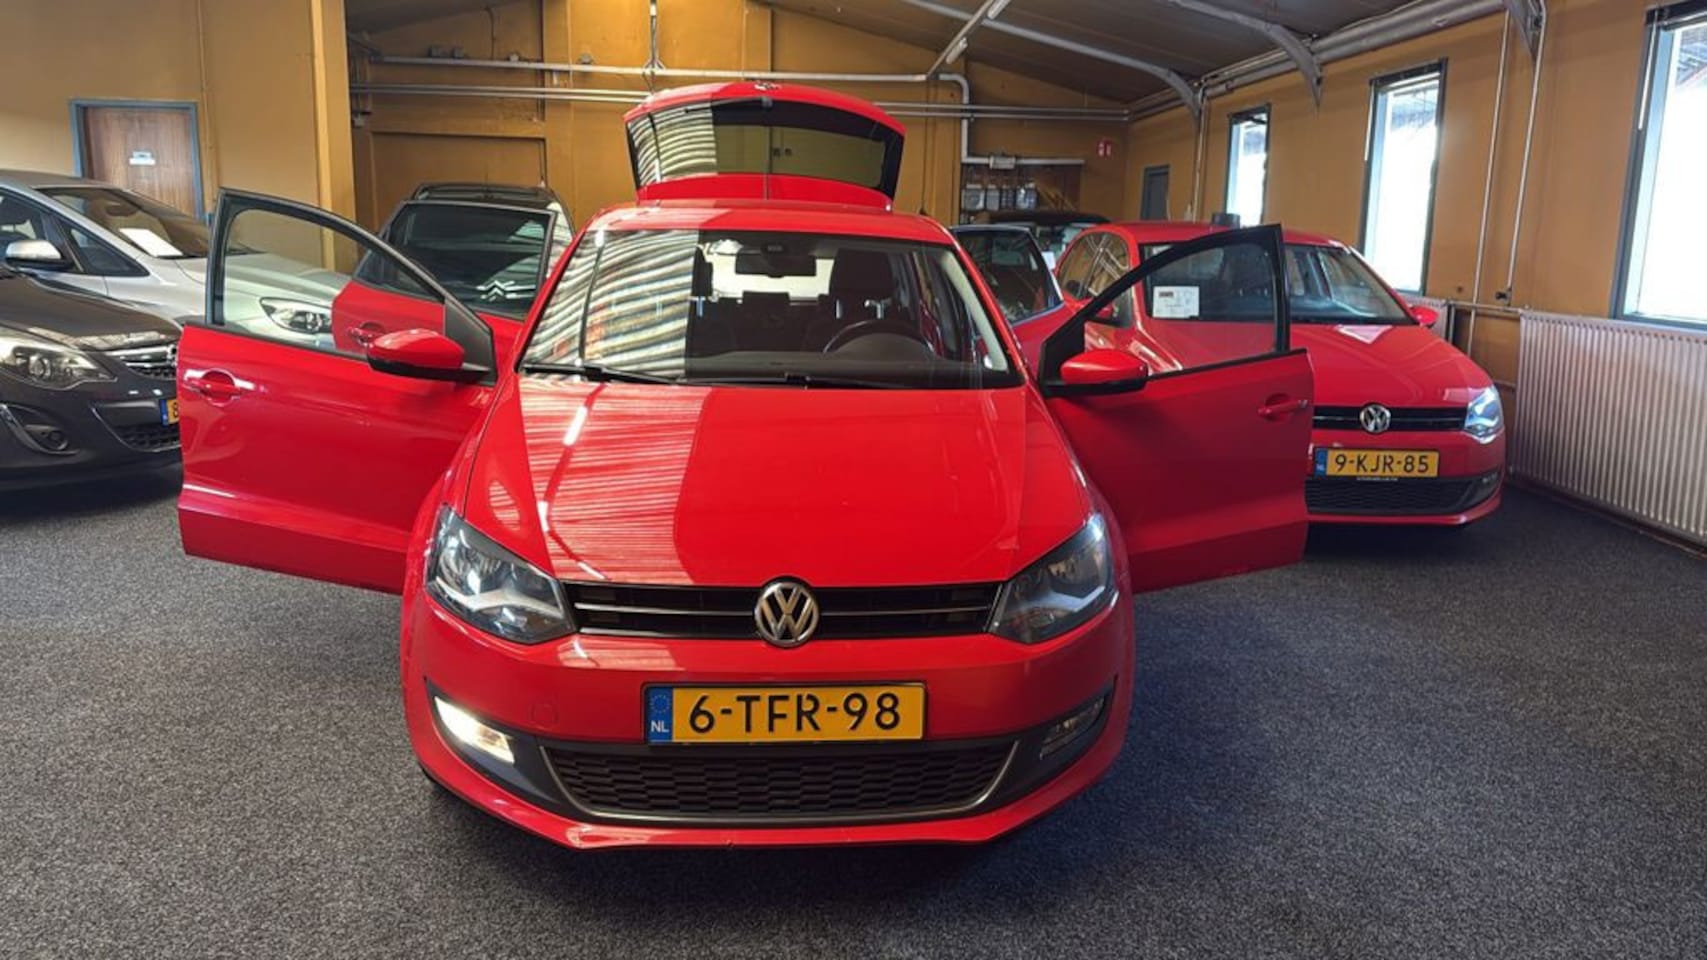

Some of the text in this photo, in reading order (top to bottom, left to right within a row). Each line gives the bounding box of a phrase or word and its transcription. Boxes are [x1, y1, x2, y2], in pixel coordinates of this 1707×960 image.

[1335, 454, 1430, 474] 9-KJR-85
[689, 692, 901, 734] 6-TFR-98
[650, 720, 670, 733] NL
